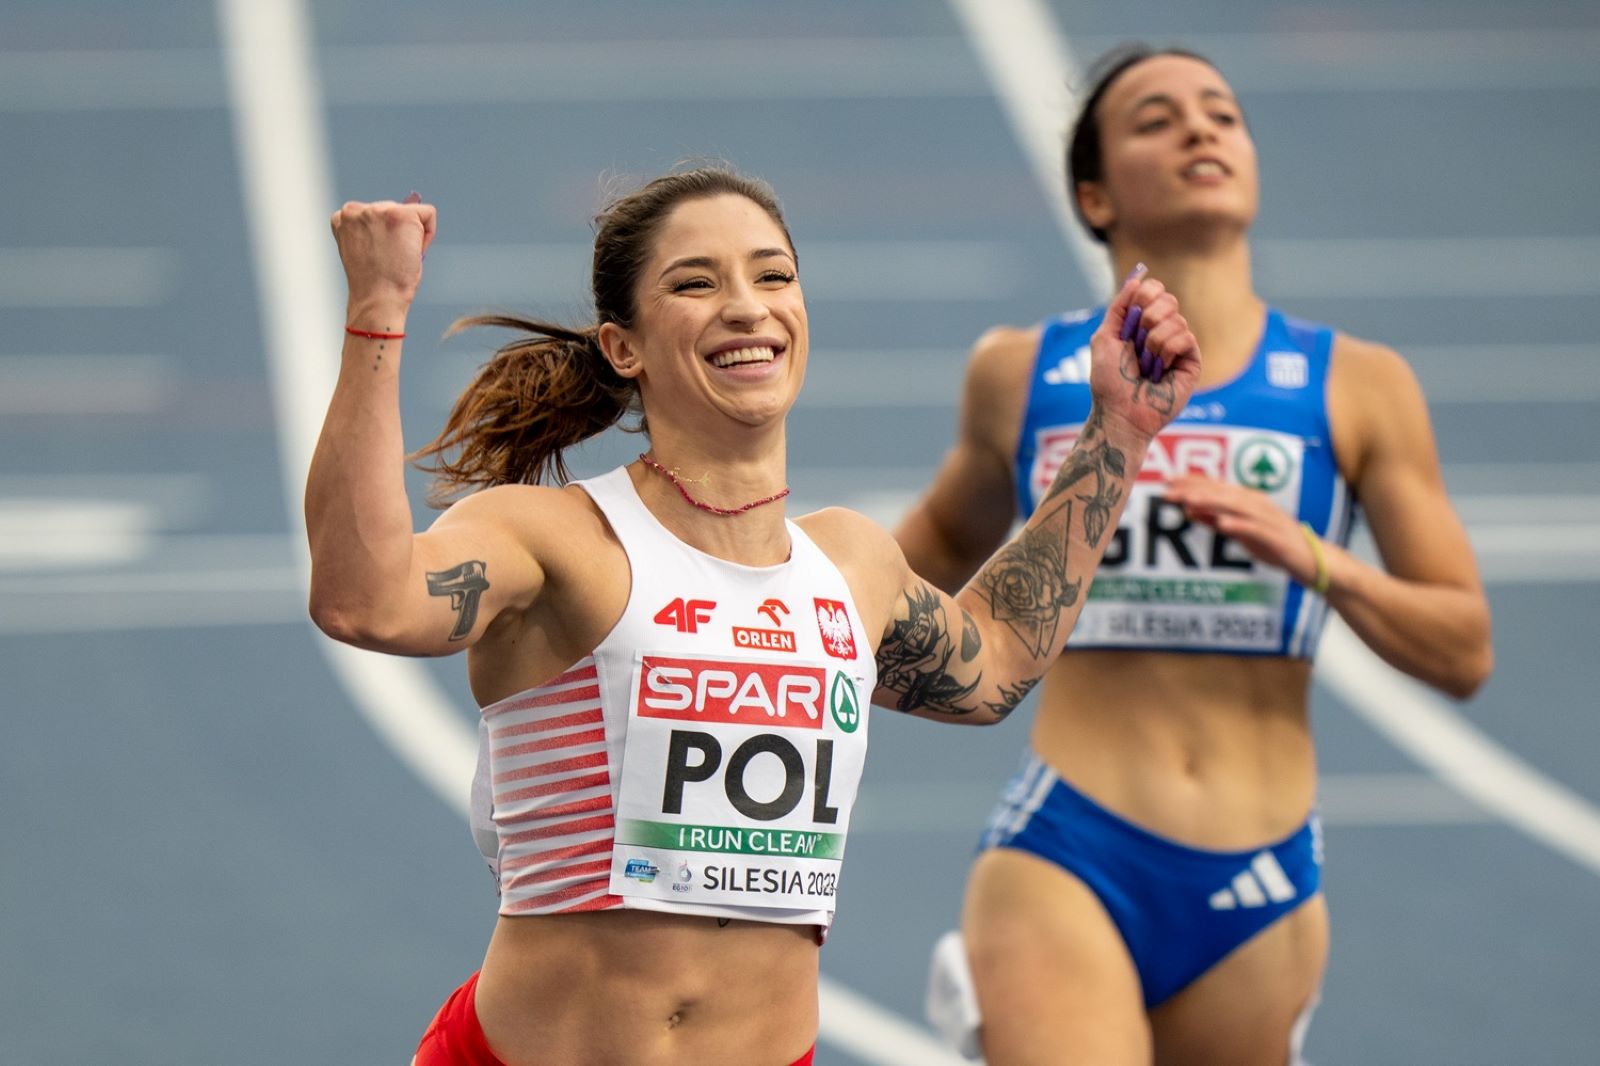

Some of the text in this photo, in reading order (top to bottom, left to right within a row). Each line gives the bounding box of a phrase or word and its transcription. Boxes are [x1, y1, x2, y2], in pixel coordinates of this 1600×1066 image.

[1042, 437, 1222, 480] SAR
[653, 597, 717, 634] 4F
[736, 630, 793, 650] ORLEN
[645, 666, 821, 720] SPAR
[662, 729, 839, 825] POL
[679, 827, 685, 847] I
[691, 828, 742, 850] RUN
[703, 865, 836, 897] SILESIA 2023
